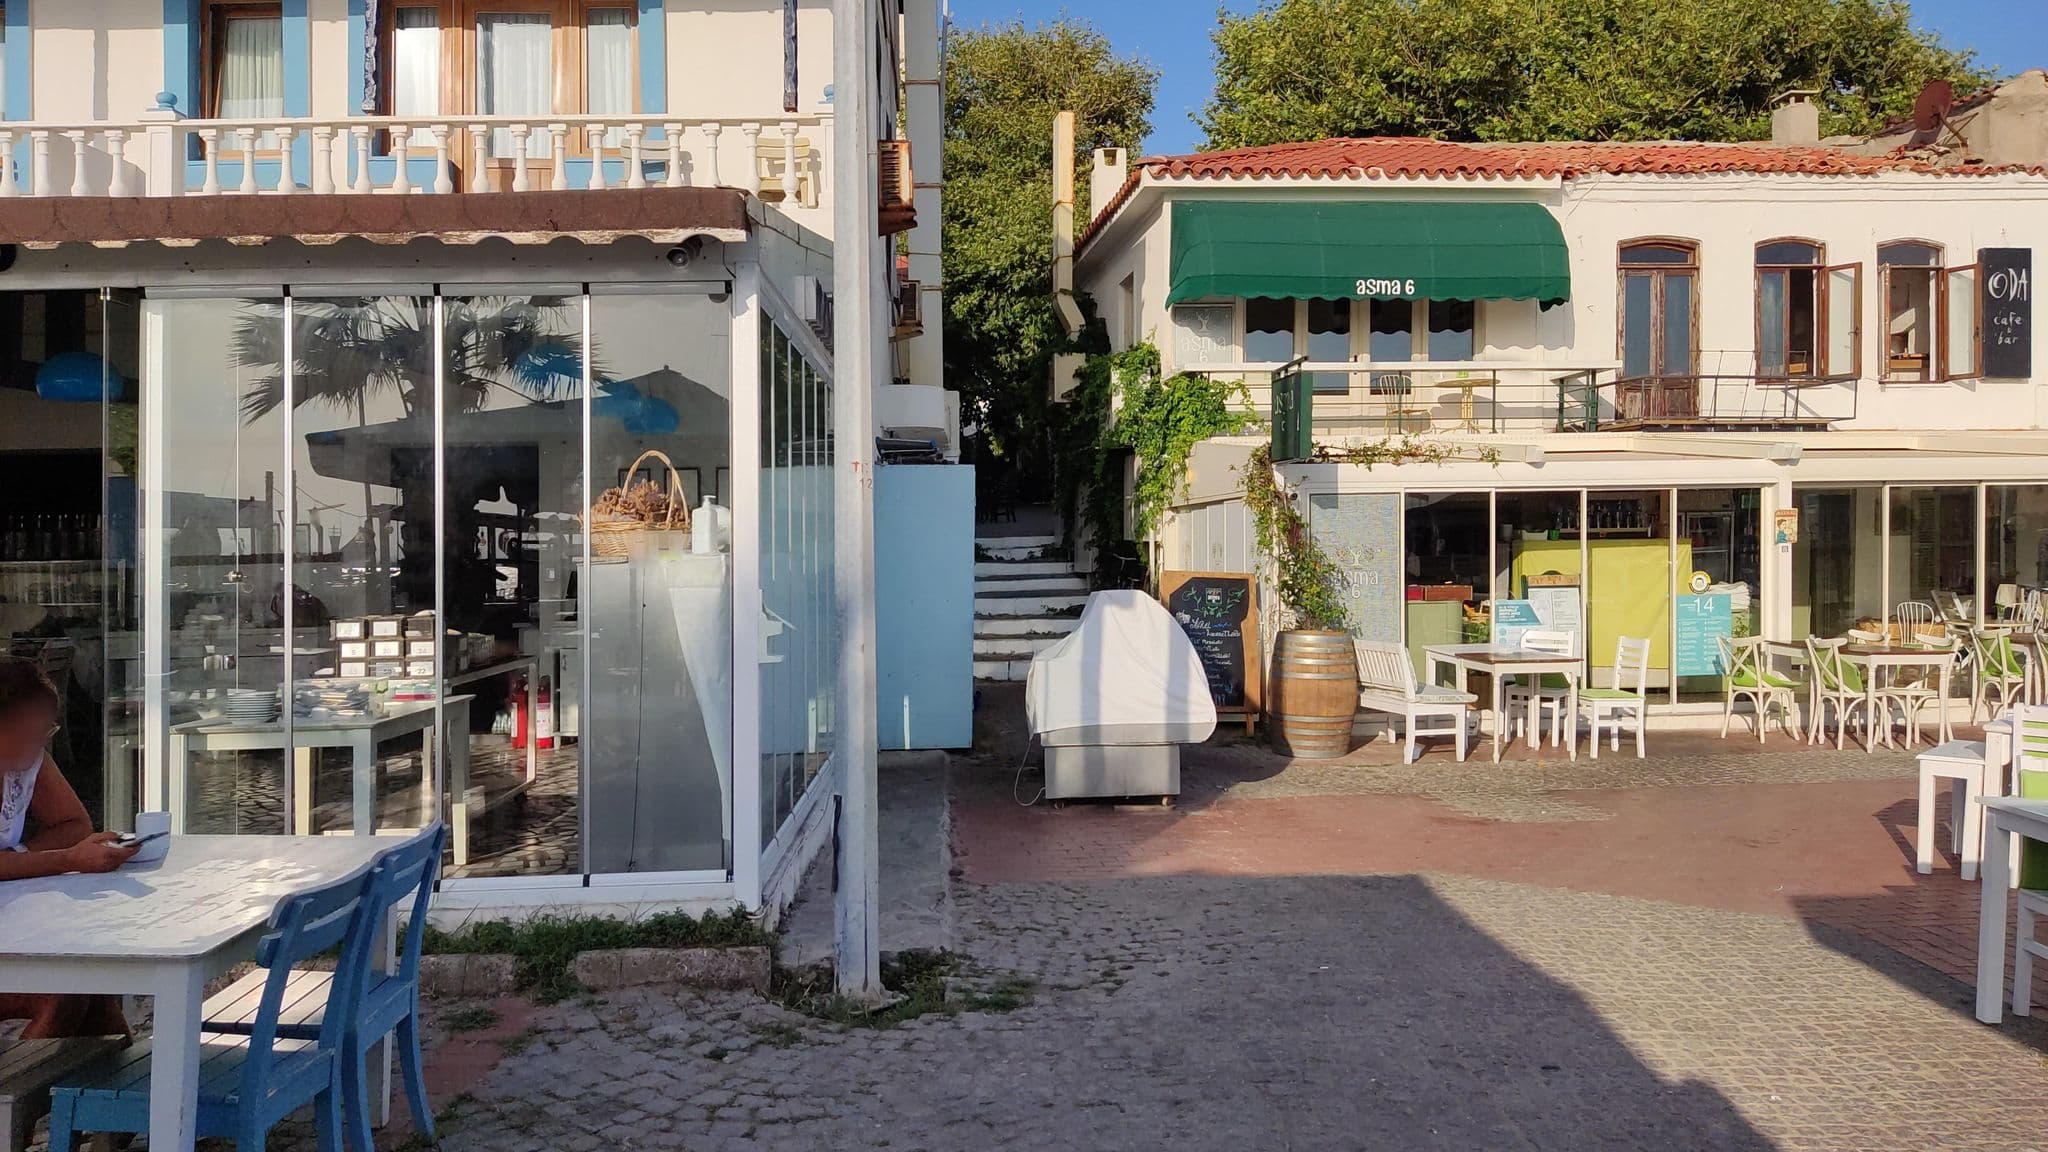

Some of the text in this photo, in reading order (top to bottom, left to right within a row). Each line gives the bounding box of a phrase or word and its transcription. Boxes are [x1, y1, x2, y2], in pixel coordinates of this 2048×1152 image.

[1356, 279, 1415, 295] asma 6
[1988, 268, 2028, 301] ODA
[1993, 311, 2022, 327] cafe
[1180, 336, 1226, 352] asma
[1997, 331, 2018, 345] bar
[1199, 350, 1209, 362] 6
[1351, 584, 1361, 598] 6
[1694, 597, 1714, 613] 14
